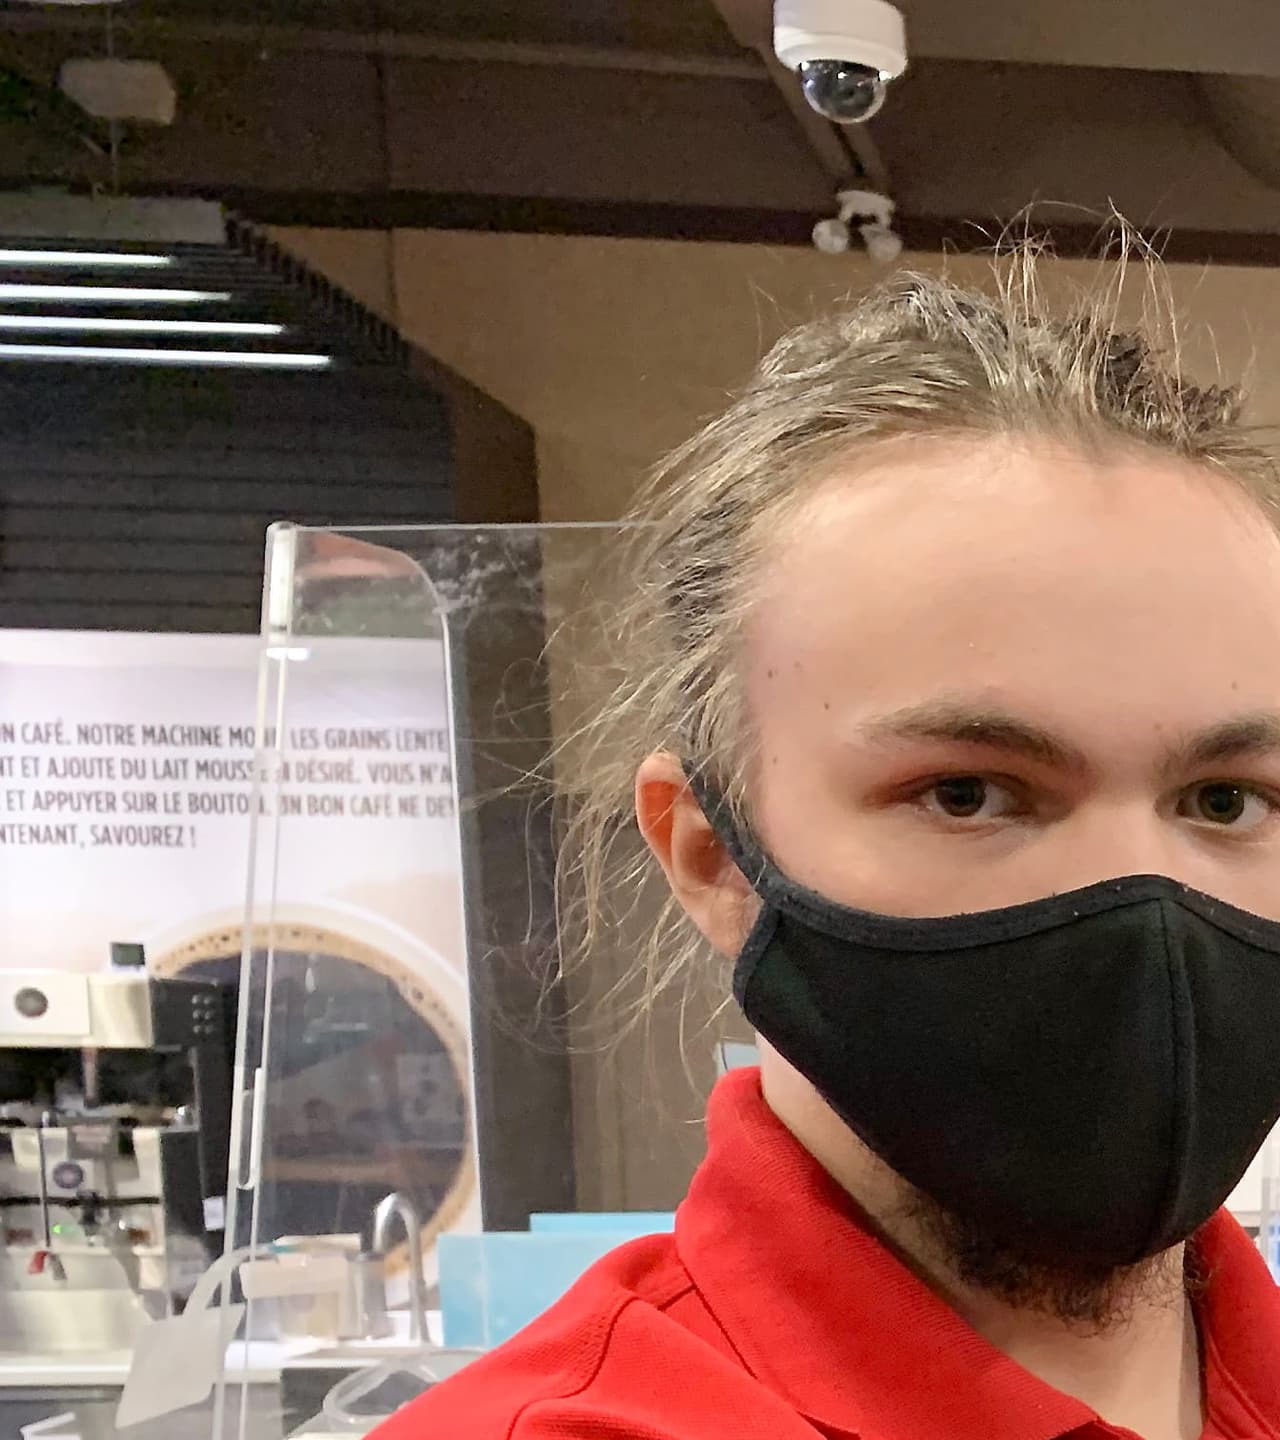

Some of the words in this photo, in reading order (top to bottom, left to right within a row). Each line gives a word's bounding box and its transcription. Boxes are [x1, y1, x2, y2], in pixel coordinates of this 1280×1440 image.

[21, 717, 71, 746] CAFÉ.
[77, 724, 136, 746] NOTRE
[142, 725, 222, 747] MACHINE
[290, 728, 319, 750] LES
[325, 728, 392, 750] GRAINS
[21, 757, 40, 778] ET
[48, 757, 116, 779] AJOUTE
[121, 758, 147, 779] DU
[152, 759, 189, 780] LAIT
[368, 763, 414, 784] VOUS
[7, 790, 25, 811] ET
[33, 790, 117, 812] APPUYER
[122, 791, 158, 813] SUR
[163, 792, 183, 813] LE
[307, 795, 344, 816] BON
[350, 793, 391, 817] CAFÉ
[398, 796, 422, 817] NE
[90, 825, 184, 847] SAVOUREZ
